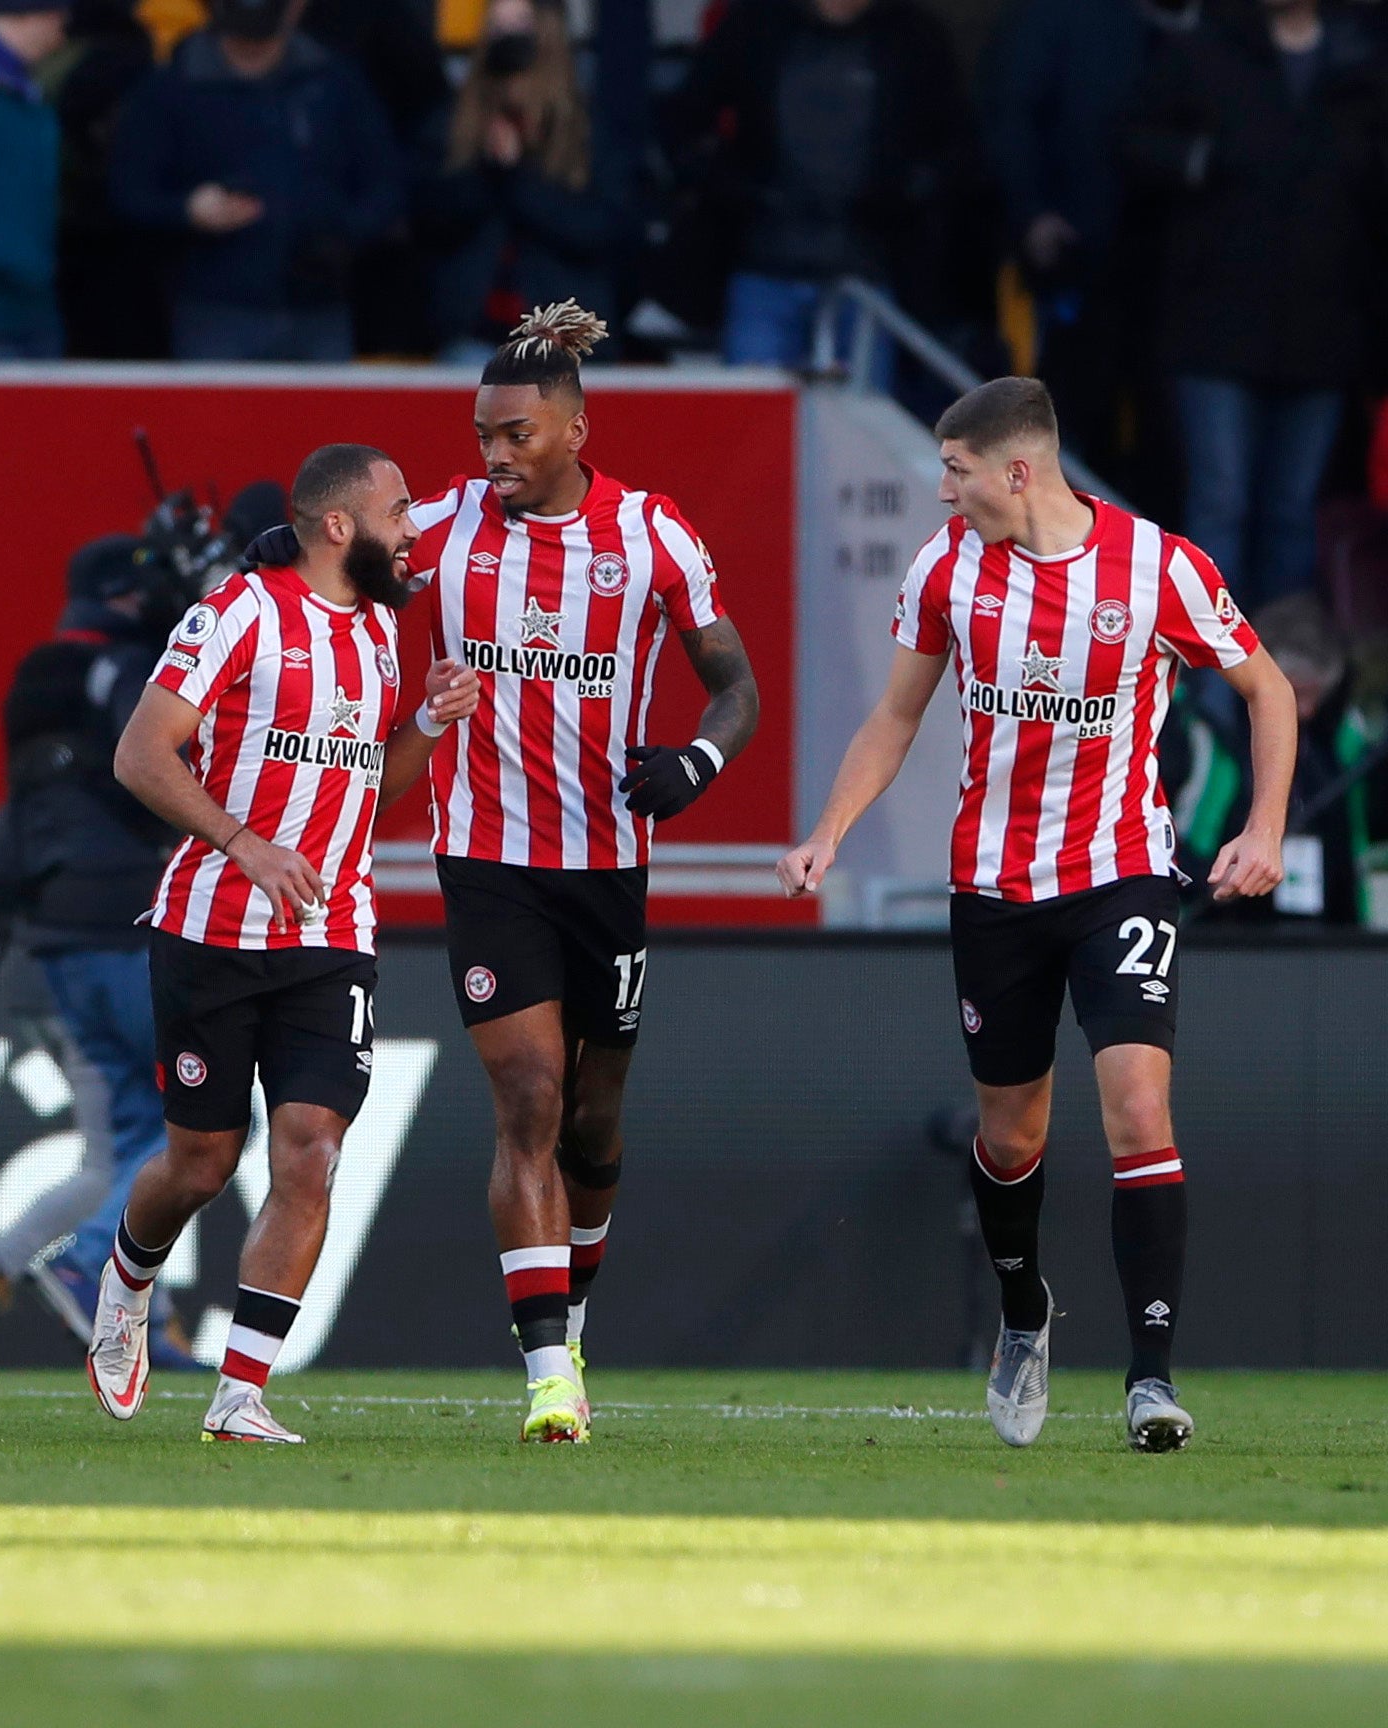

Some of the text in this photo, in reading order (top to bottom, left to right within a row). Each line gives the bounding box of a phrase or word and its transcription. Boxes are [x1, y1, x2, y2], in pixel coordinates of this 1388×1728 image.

[462, 640, 616, 681] HOLLYWOOD
[578, 681, 613, 696] bets
[970, 680, 1116, 724] HOLLYWOOD
[1078, 722, 1114, 738] bets
[1115, 915, 1177, 978] 27
[614, 946, 647, 1010] 17
